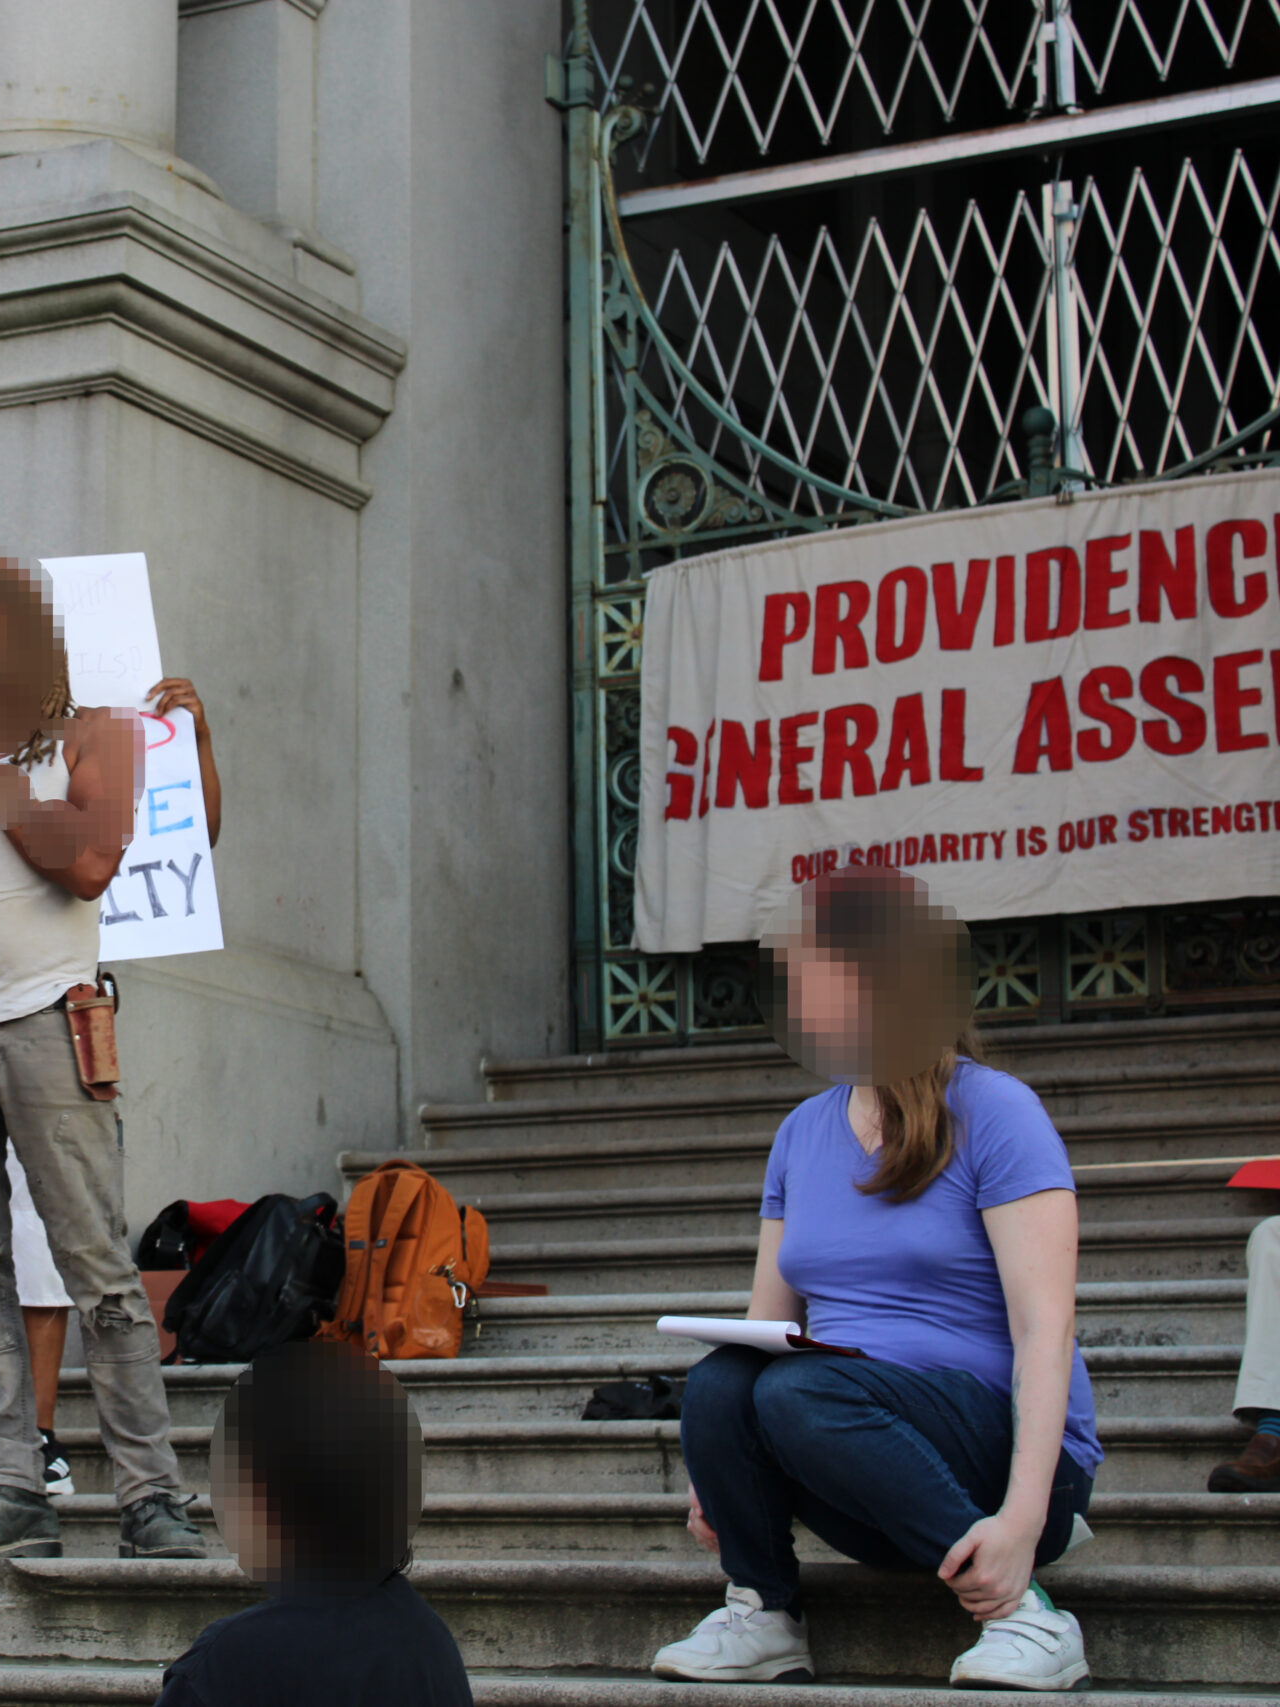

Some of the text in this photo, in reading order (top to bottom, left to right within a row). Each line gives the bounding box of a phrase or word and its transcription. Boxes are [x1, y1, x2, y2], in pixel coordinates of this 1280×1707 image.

[758, 513, 1280, 682] PROVIDENC
[1012, 648, 1280, 775] ASSE
[791, 848, 839, 884] OUR
[848, 831, 1007, 868] SOLIDARITY
[1019, 825, 1048, 857] IS
[1058, 813, 1118, 854] OUR
